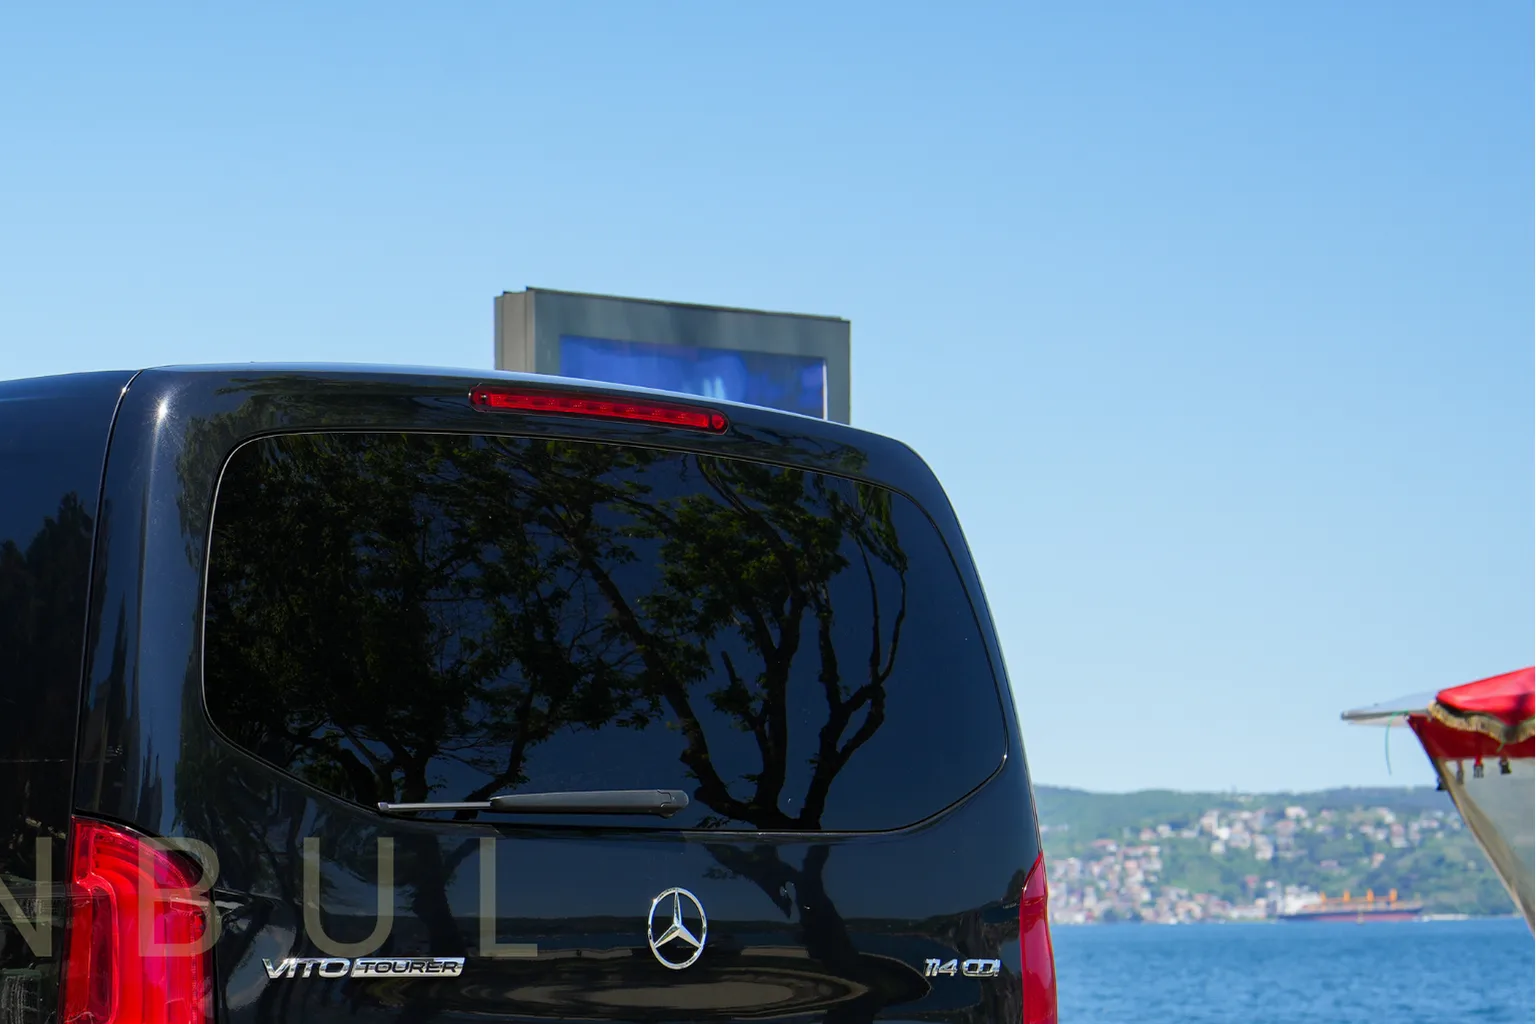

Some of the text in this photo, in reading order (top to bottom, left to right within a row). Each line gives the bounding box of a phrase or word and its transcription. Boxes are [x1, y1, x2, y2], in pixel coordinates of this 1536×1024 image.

[261, 956, 460, 978] VITO TOURER
[924, 958, 958, 977] 114
